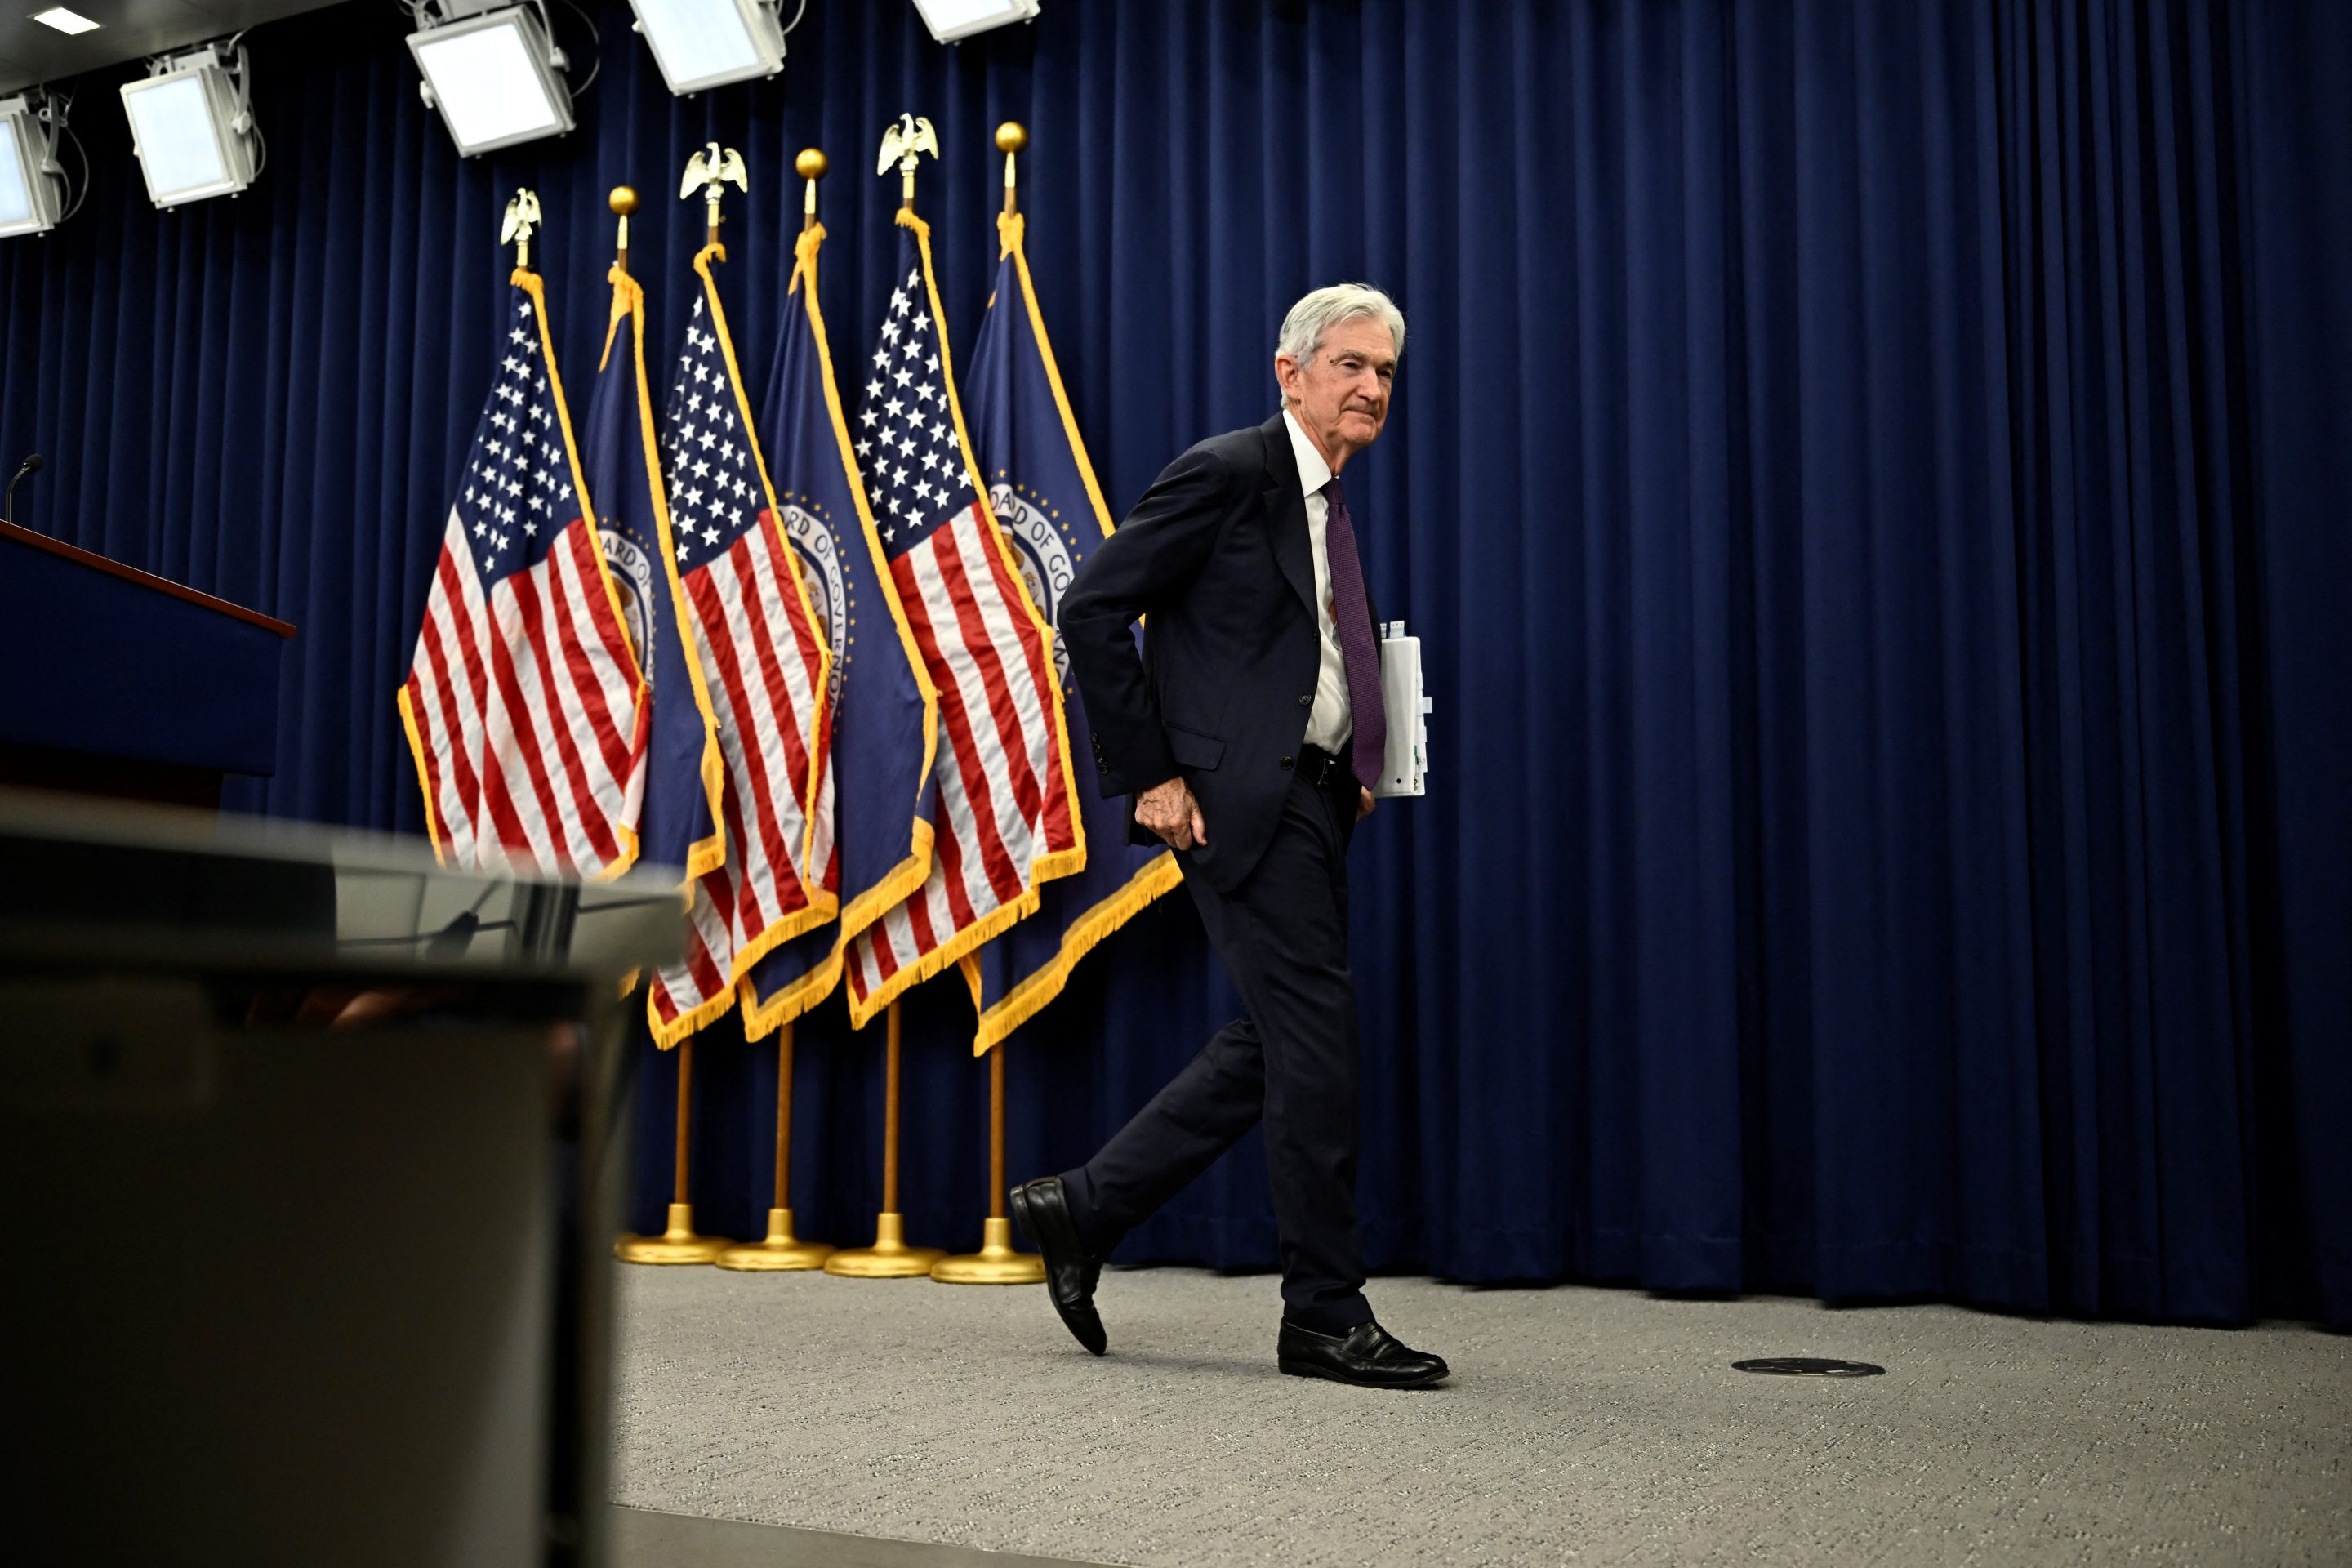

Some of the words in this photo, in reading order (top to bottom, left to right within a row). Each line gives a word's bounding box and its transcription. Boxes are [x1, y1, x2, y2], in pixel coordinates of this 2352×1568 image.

[1031, 521, 1055, 549] OF
[603, 537, 636, 567] ARD
[828, 565, 843, 710] GOVERNO
